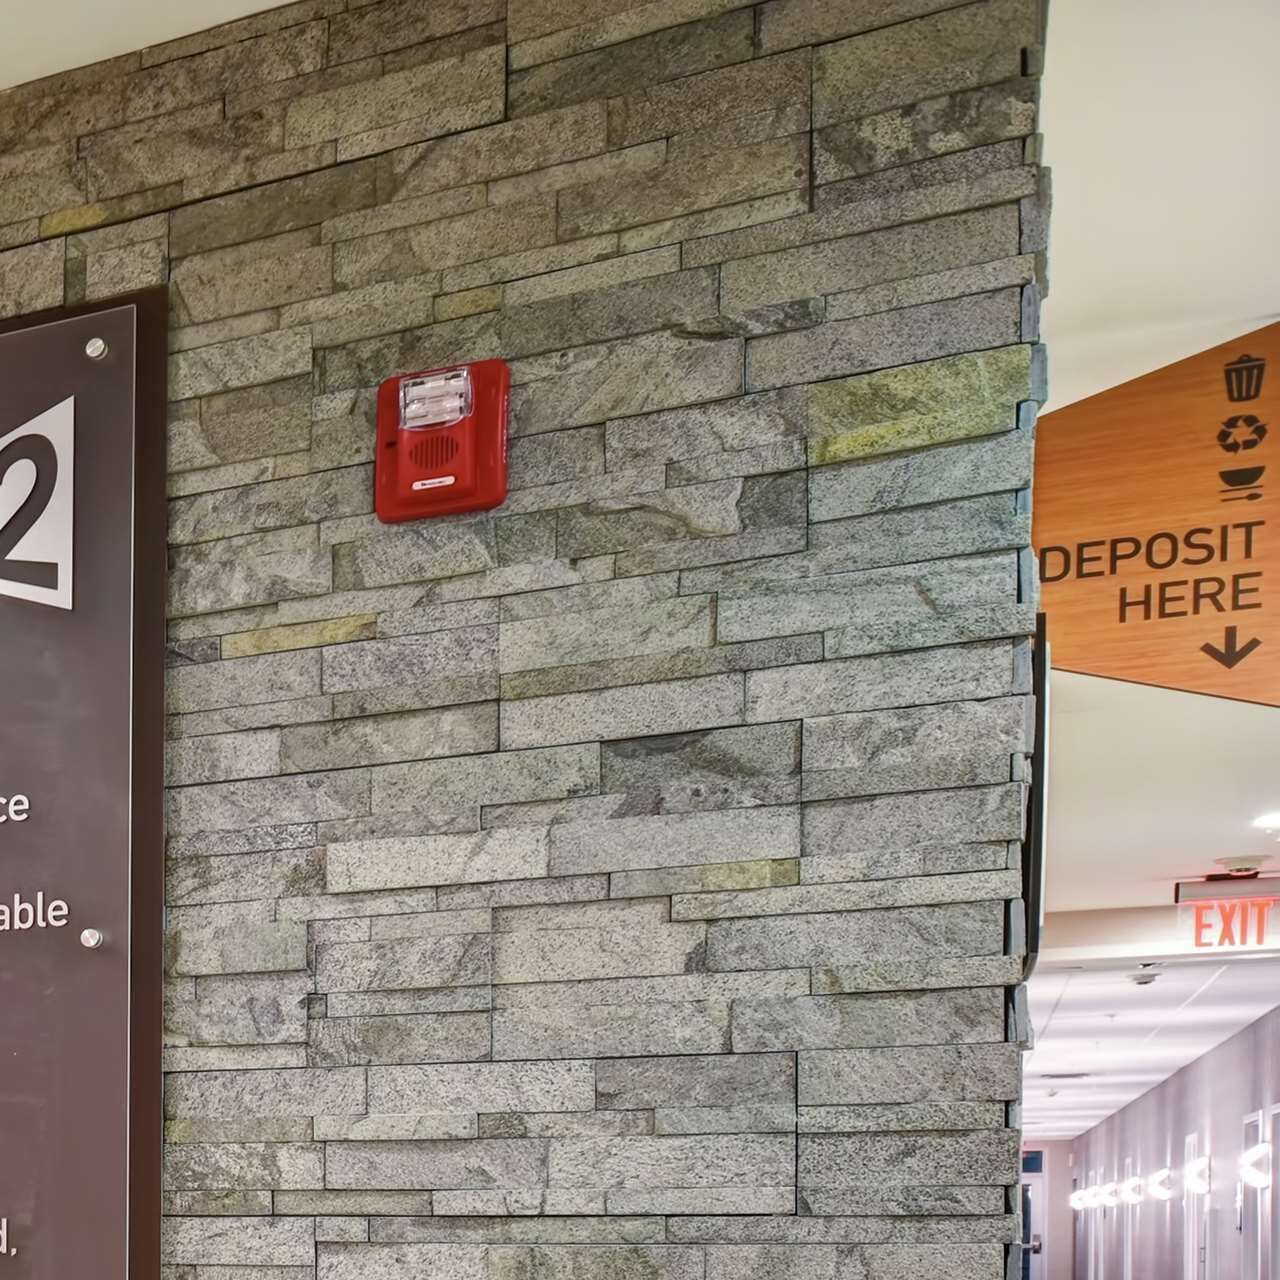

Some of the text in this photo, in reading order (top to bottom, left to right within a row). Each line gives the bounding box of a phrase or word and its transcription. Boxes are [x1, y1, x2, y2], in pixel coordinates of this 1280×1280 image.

[1039, 520, 1266, 583] DEPOSIT
[1118, 571, 1263, 624] HERE
[1194, 900, 1275, 948] EXIT
